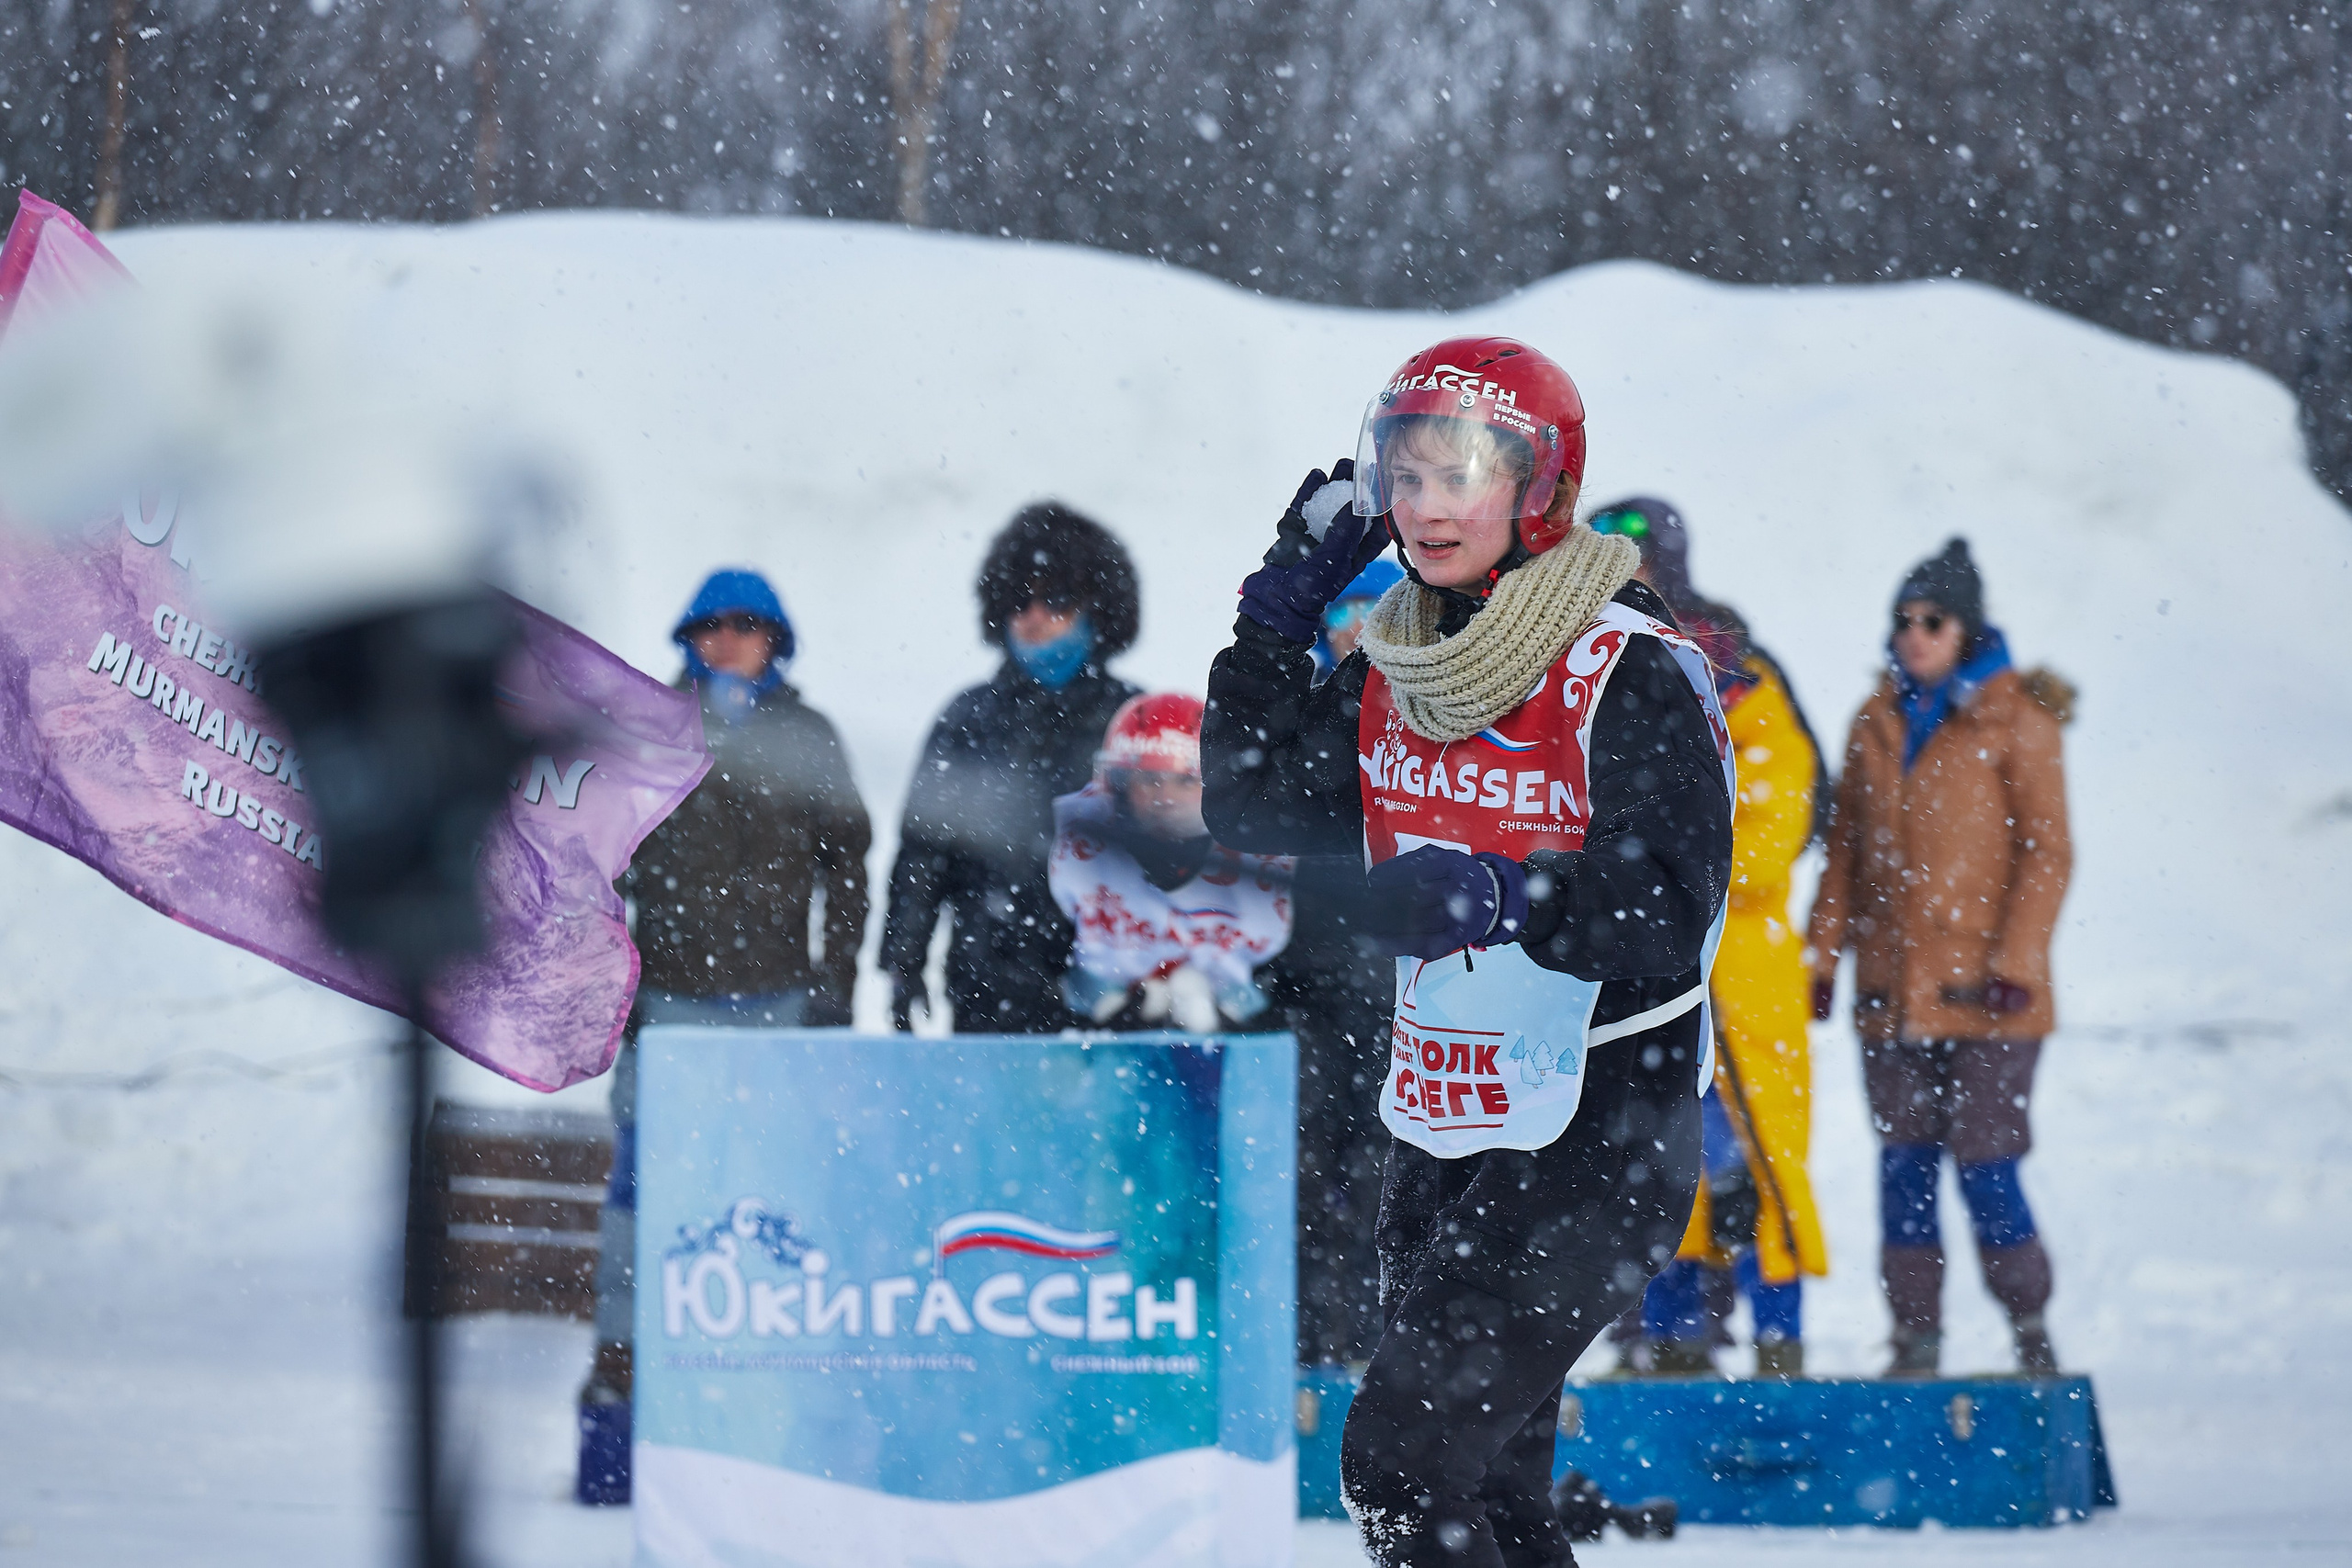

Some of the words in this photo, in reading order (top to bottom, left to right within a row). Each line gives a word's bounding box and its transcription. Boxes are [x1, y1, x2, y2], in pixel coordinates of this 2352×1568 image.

[1493, 412, 1500, 421] В
[1500, 415, 1536, 434] РОССИИ
[1494, 403, 1532, 422] ПЕРВЫЕ
[86, 630, 305, 793] MURMANSK
[181, 759, 323, 872] RUSSIA
[1498, 819, 1561, 833] СНЕЖНЫЙ
